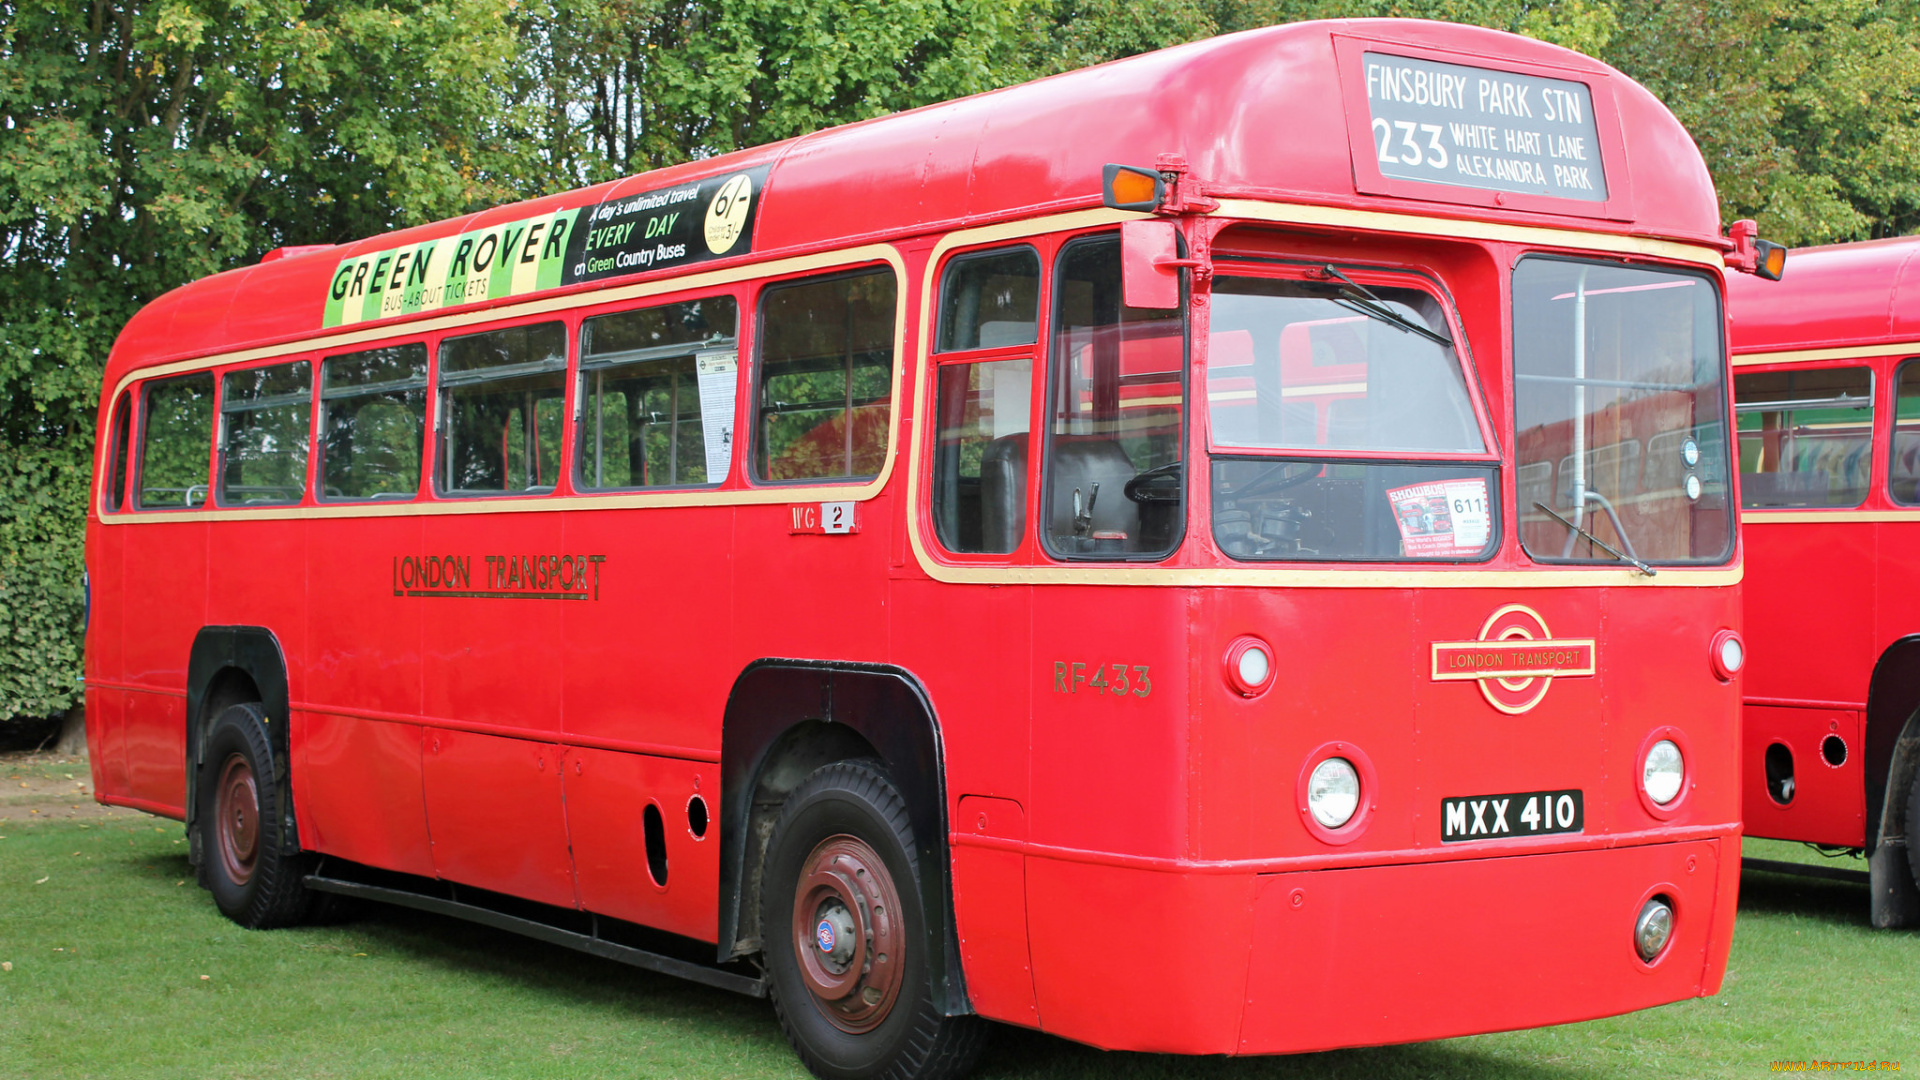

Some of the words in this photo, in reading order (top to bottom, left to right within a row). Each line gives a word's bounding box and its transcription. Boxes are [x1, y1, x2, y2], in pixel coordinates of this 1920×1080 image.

[1367, 64, 1467, 110] FINSBURY
[1479, 79, 1533, 119] PARK
[1542, 88, 1582, 124] STN
[1371, 117, 1448, 169] 233
[1449, 122, 1499, 151] WHITE
[1504, 129, 1541, 156] HART
[1548, 134, 1587, 161] LANE
[1456, 154, 1547, 186] ALEXANDRA
[1553, 164, 1593, 190] PARK
[587, 206, 598, 223] A
[598, 202, 624, 221] day's
[623, 193, 669, 215] unlimited
[670, 184, 701, 203] travel
[715, 176, 748, 219] 6/-
[585, 221, 636, 251] EVERY
[644, 212, 680, 239] DAY
[332, 247, 434, 301] GREEN
[450, 218, 568, 278] ROVER
[587, 255, 615, 275] Green
[616, 247, 656, 268] Country
[656, 243, 686, 262] Buses
[384, 286, 443, 312] BUS-ABOUT
[445, 278, 488, 301] TICKETS
[792, 507, 815, 529] WG
[832, 506, 843, 528] 2
[1454, 498, 1482, 514] 611
[393, 555, 470, 596] LONDON
[485, 555, 606, 601] TRANSPORT
[1450, 653, 1503, 668] LONDON
[1512, 650, 1580, 666] TRANSPORT
[1054, 661, 1151, 698] RF433
[1446, 799, 1510, 836] MXX
[1520, 794, 1575, 830] 410
